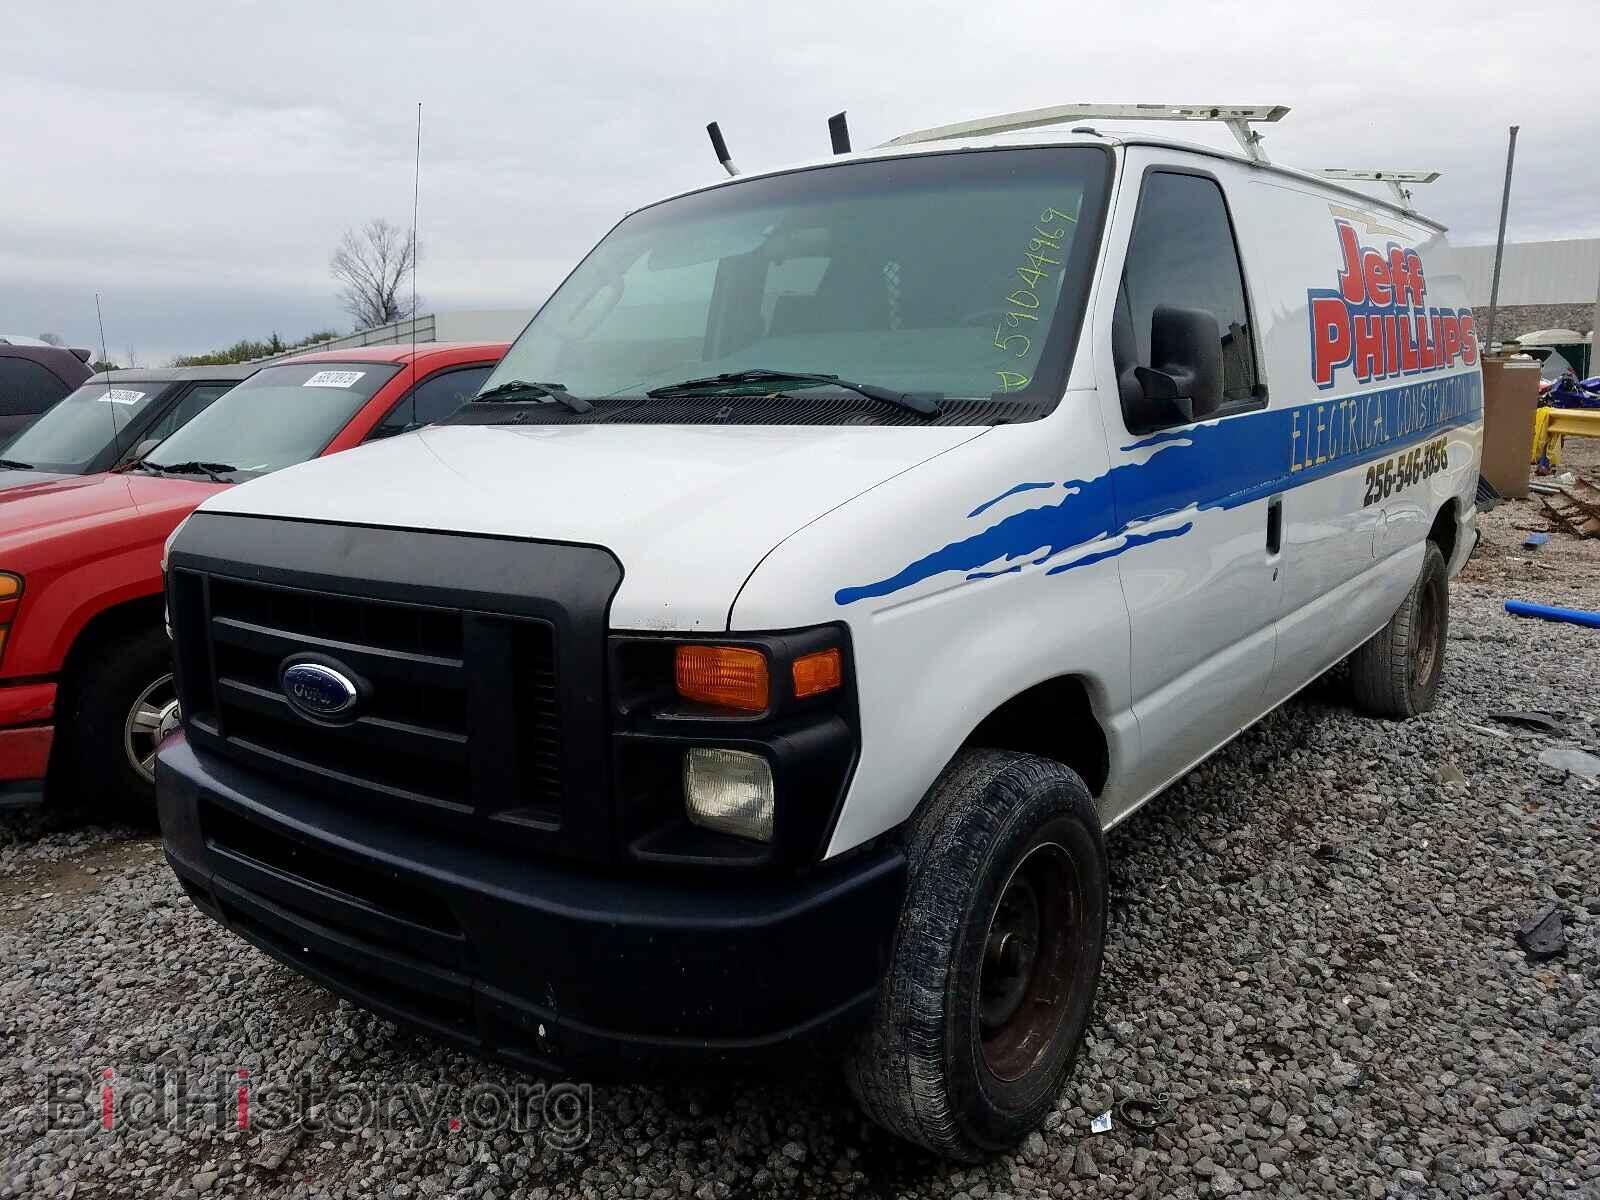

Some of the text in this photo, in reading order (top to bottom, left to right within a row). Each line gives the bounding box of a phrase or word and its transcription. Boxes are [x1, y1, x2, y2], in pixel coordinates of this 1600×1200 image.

[1334, 218, 1427, 306] Jeff
[1308, 289, 1477, 389] PHILLIPS
[1291, 394, 1390, 472] ELECTRICAL
